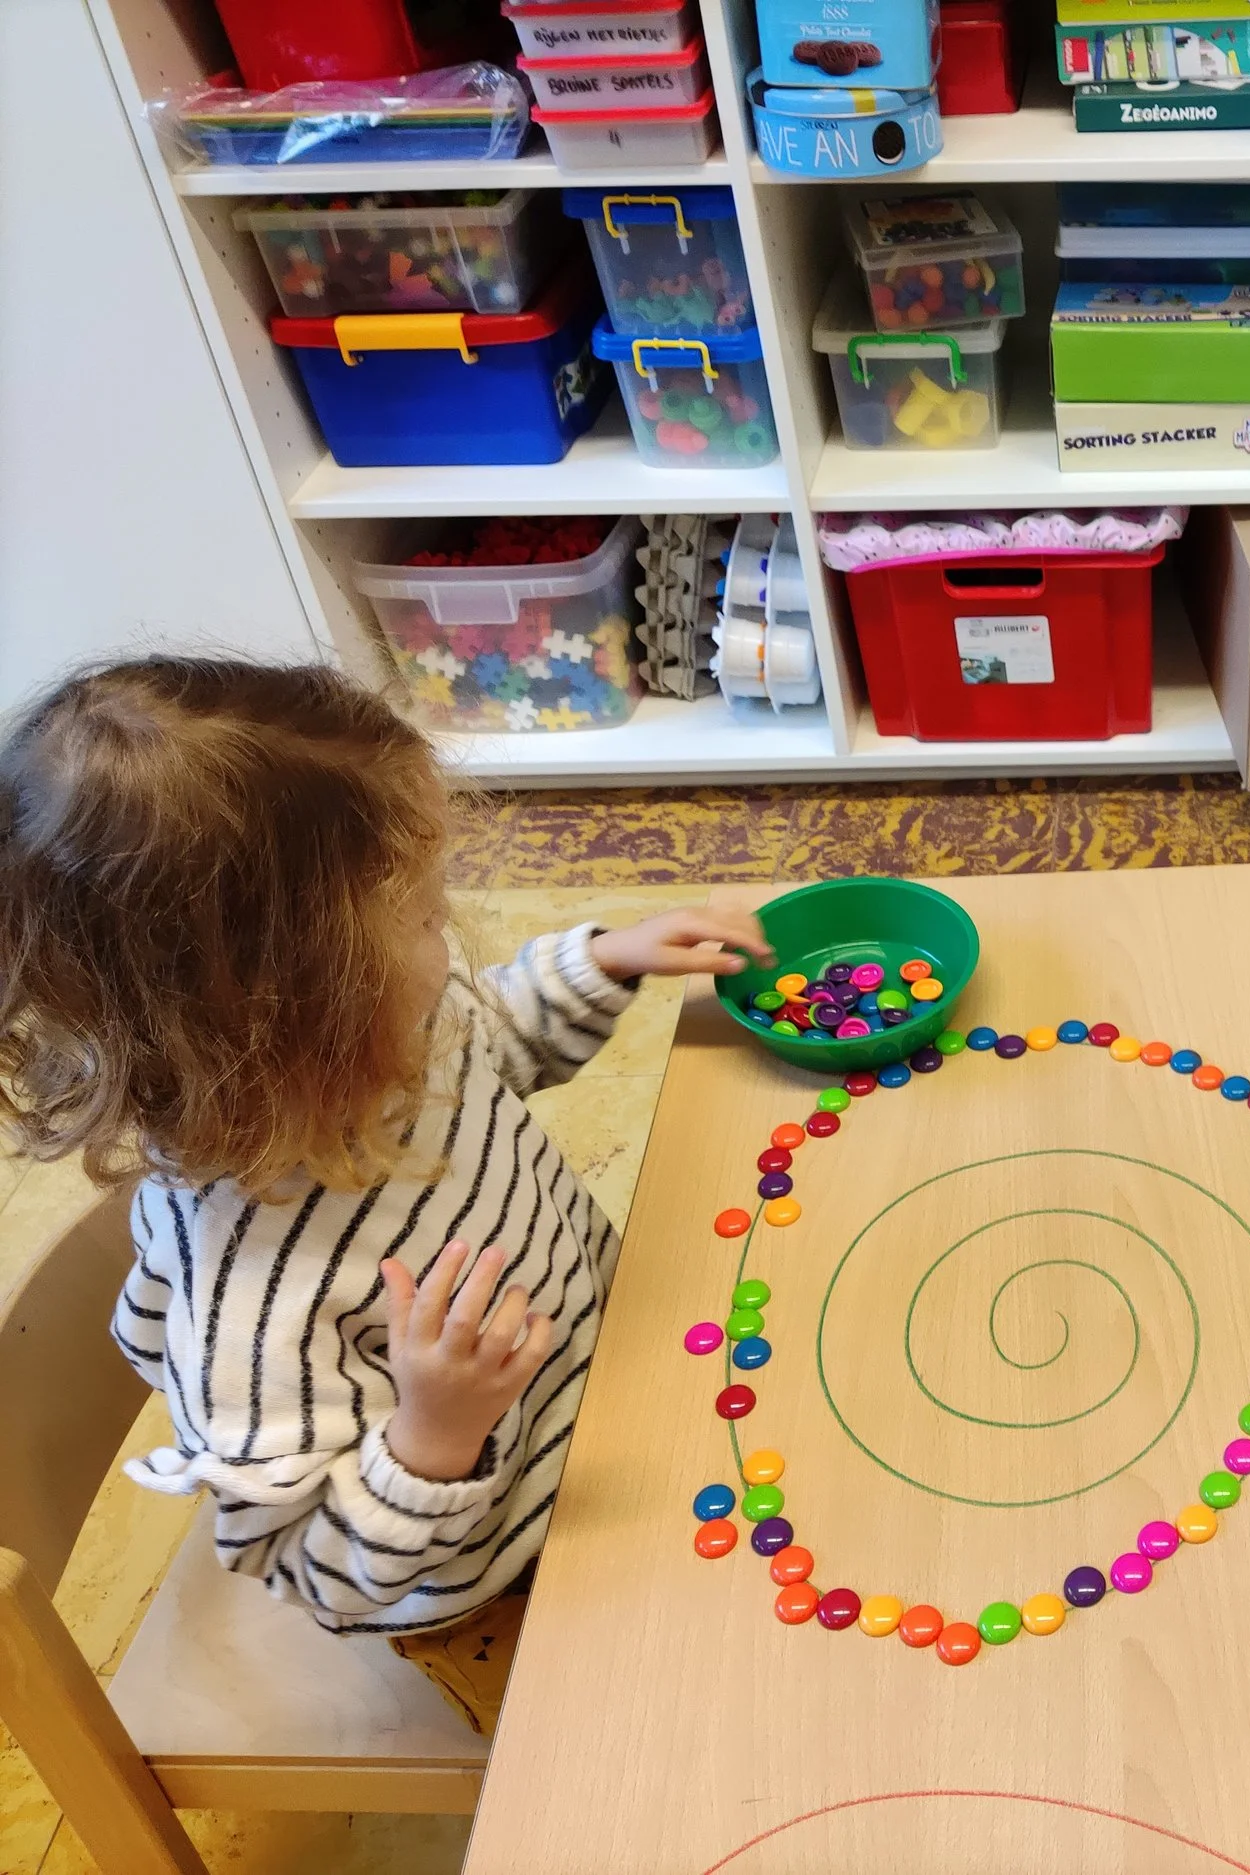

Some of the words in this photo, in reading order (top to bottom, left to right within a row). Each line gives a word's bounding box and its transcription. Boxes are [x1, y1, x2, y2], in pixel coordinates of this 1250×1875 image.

[814, 128, 859, 168] AN
[908, 111, 936, 154] TO
[1063, 433, 1136, 450] SORTING
[1142, 427, 1217, 444] STACKER
